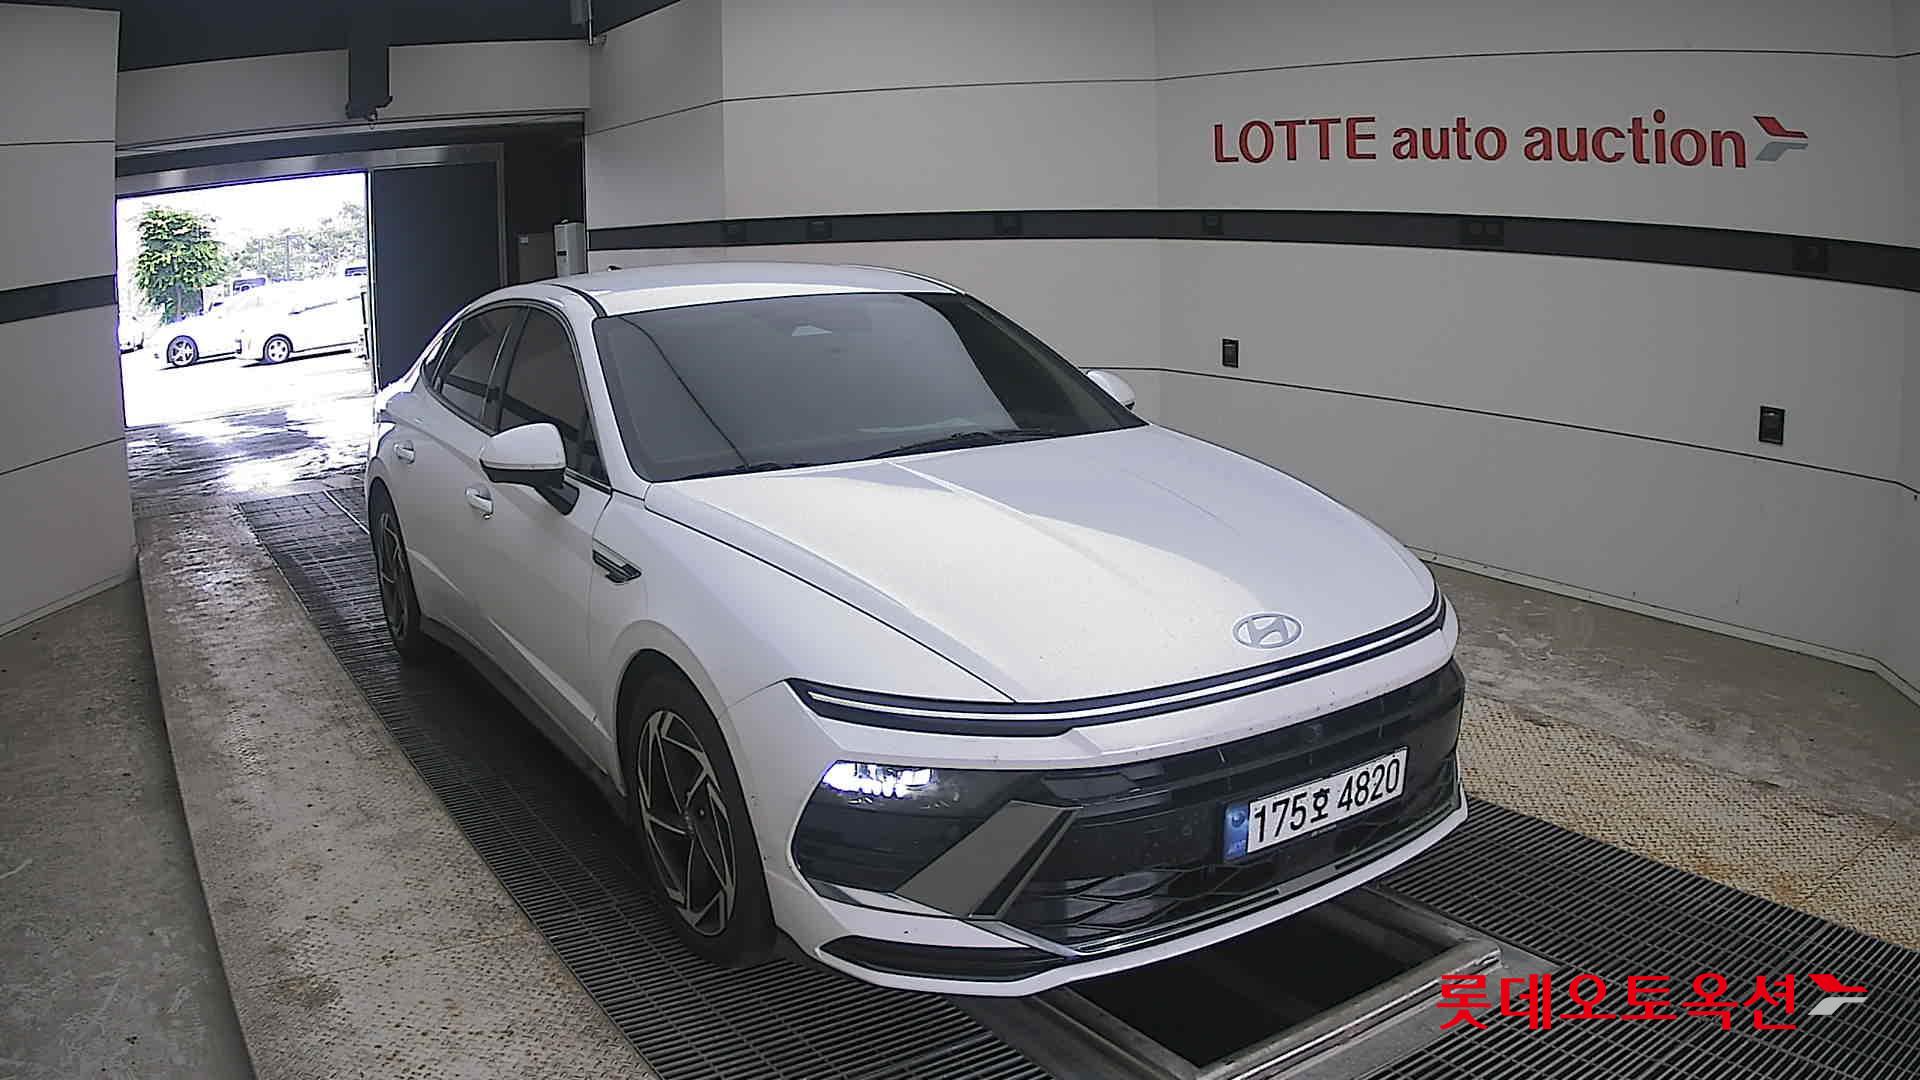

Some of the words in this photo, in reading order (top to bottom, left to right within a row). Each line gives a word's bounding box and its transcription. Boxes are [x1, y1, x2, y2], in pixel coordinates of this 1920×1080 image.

[1214, 117, 1376, 163] LOTTE
[1392, 117, 1507, 160] auto
[1524, 109, 1746, 168] auction
[1254, 787, 1330, 843] 175호
[1337, 758, 1400, 812] 4820
